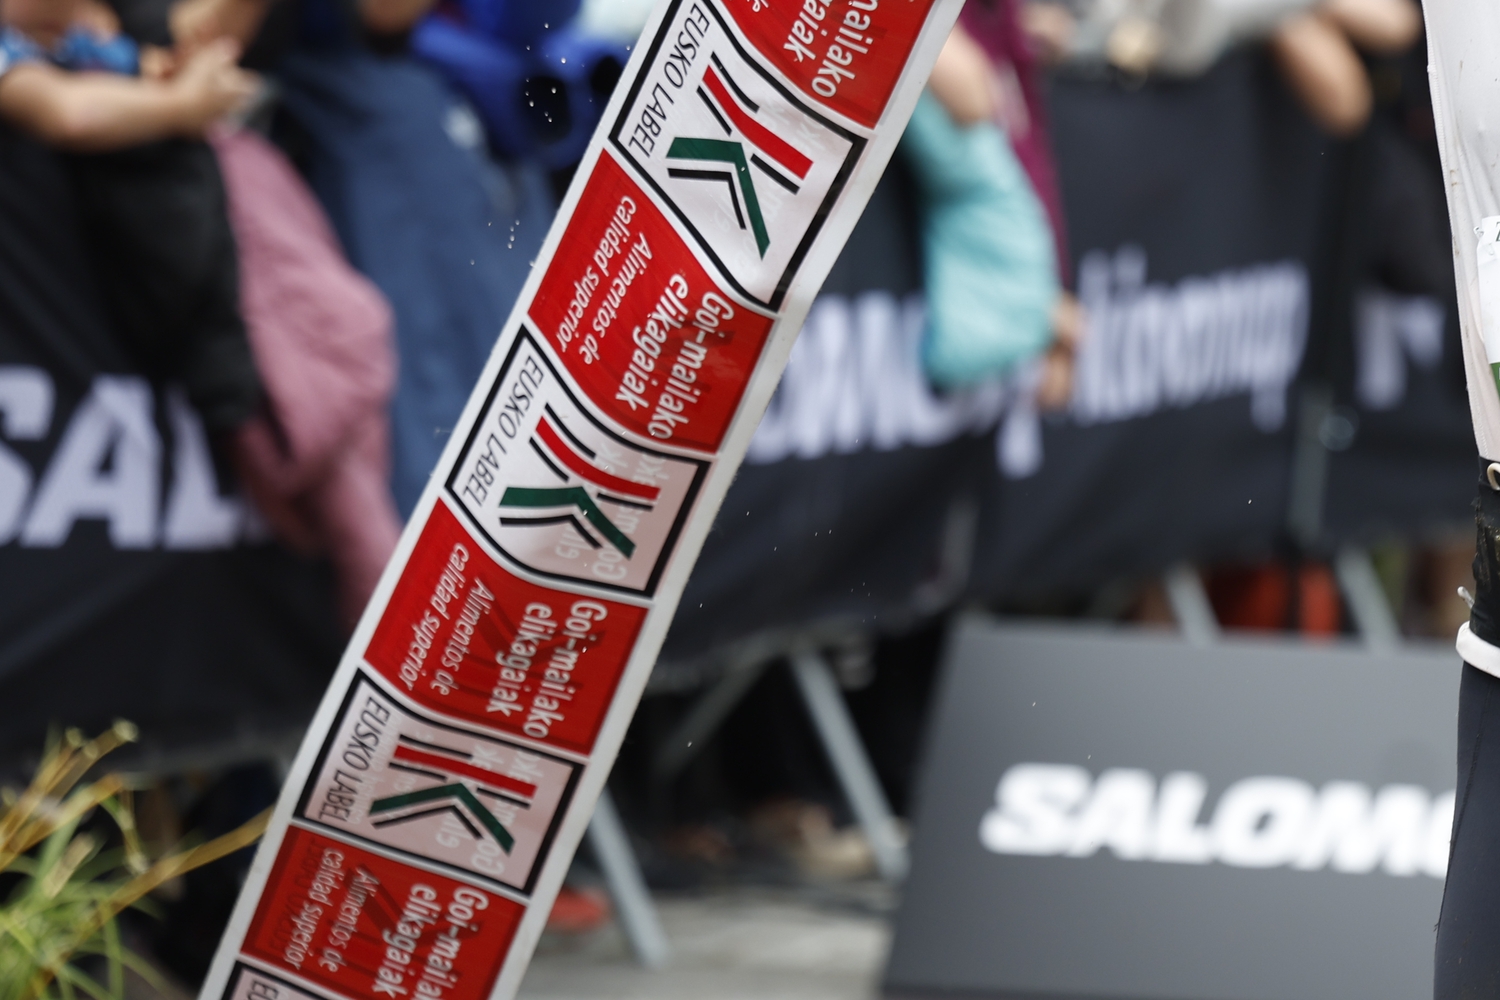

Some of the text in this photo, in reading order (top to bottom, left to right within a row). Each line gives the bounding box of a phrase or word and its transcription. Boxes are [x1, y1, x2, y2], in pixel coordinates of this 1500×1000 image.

[628, 2, 710, 159] EUSKO LABEL
[556, 195, 637, 352] calidad superior
[580, 233, 652, 365] Alimentos de
[615, 272, 689, 412] elikagaiak
[648, 291, 735, 440] Goi-mailako
[462, 355, 544, 507] EUSKO LABEL
[398, 542, 470, 690] calidad superior
[430, 577, 496, 696] Alimentos de
[487, 602, 557, 717] elikagaiak
[523, 600, 607, 738] Goi-mailako
[318, 696, 390, 822] EUSKO LABEL
[283, 847, 345, 969] calidad superior
[319, 868, 381, 973] Alimentos de
[371, 882, 442, 999] elikagaiak
[410, 886, 489, 1000] Goi-maila
